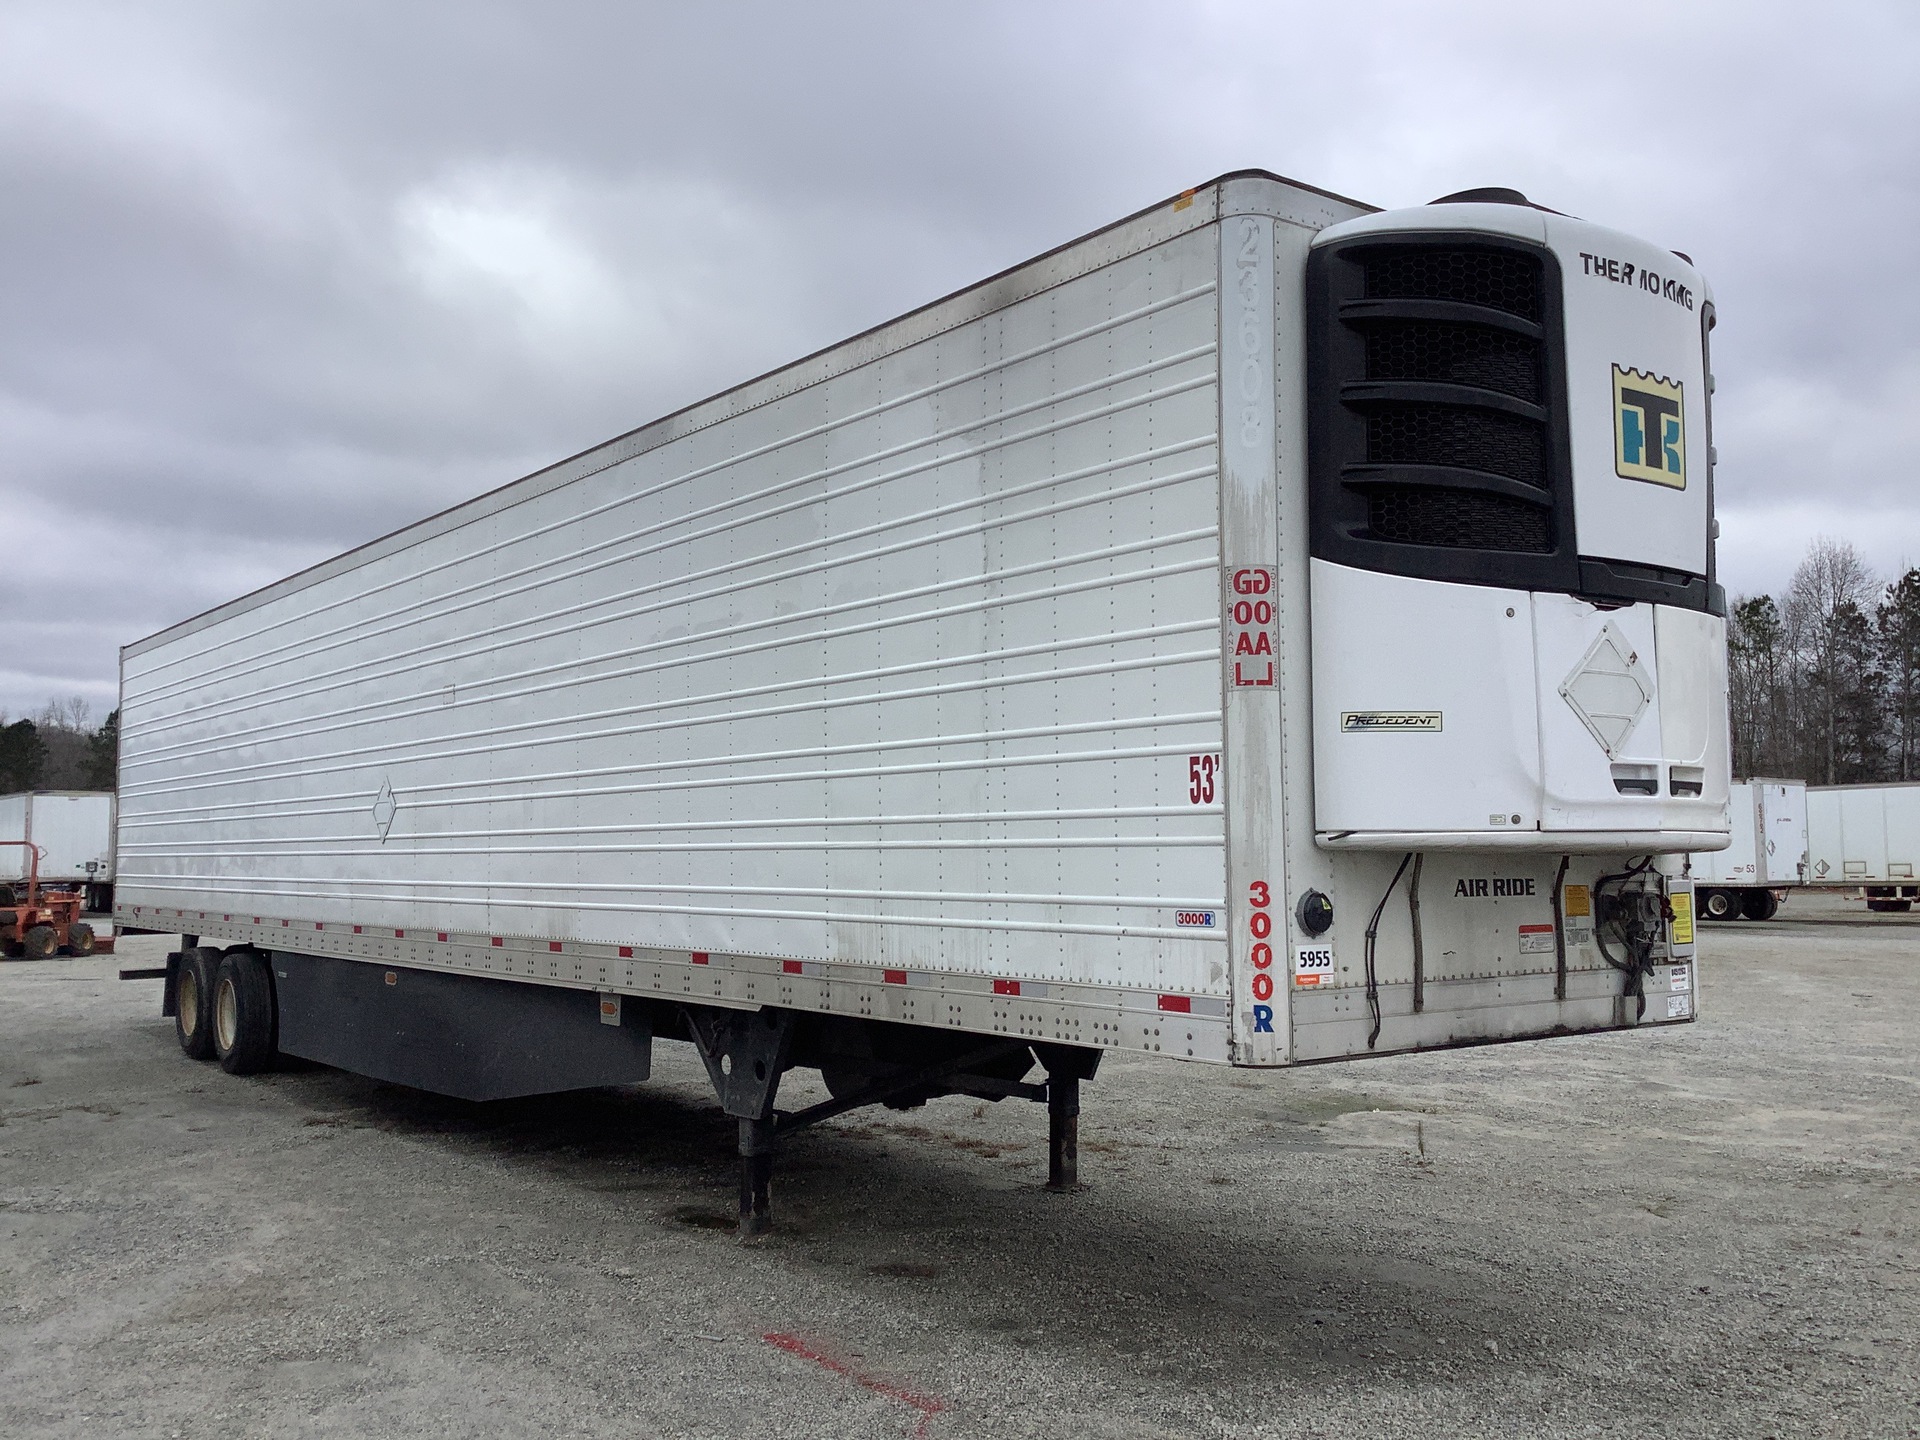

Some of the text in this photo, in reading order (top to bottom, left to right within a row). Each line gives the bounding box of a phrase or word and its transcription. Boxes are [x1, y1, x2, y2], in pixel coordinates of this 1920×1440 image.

[1663, 278, 1693, 311] KING
[1345, 714, 1439, 726] PRECEDENT
[1189, 754, 1220, 804] 53'
[1746, 864, 1755, 873] 53
[1454, 878, 1536, 897] AIR RIDE
[1249, 880, 1274, 1033] 3000R
[1300, 950, 1330, 968] 5955
